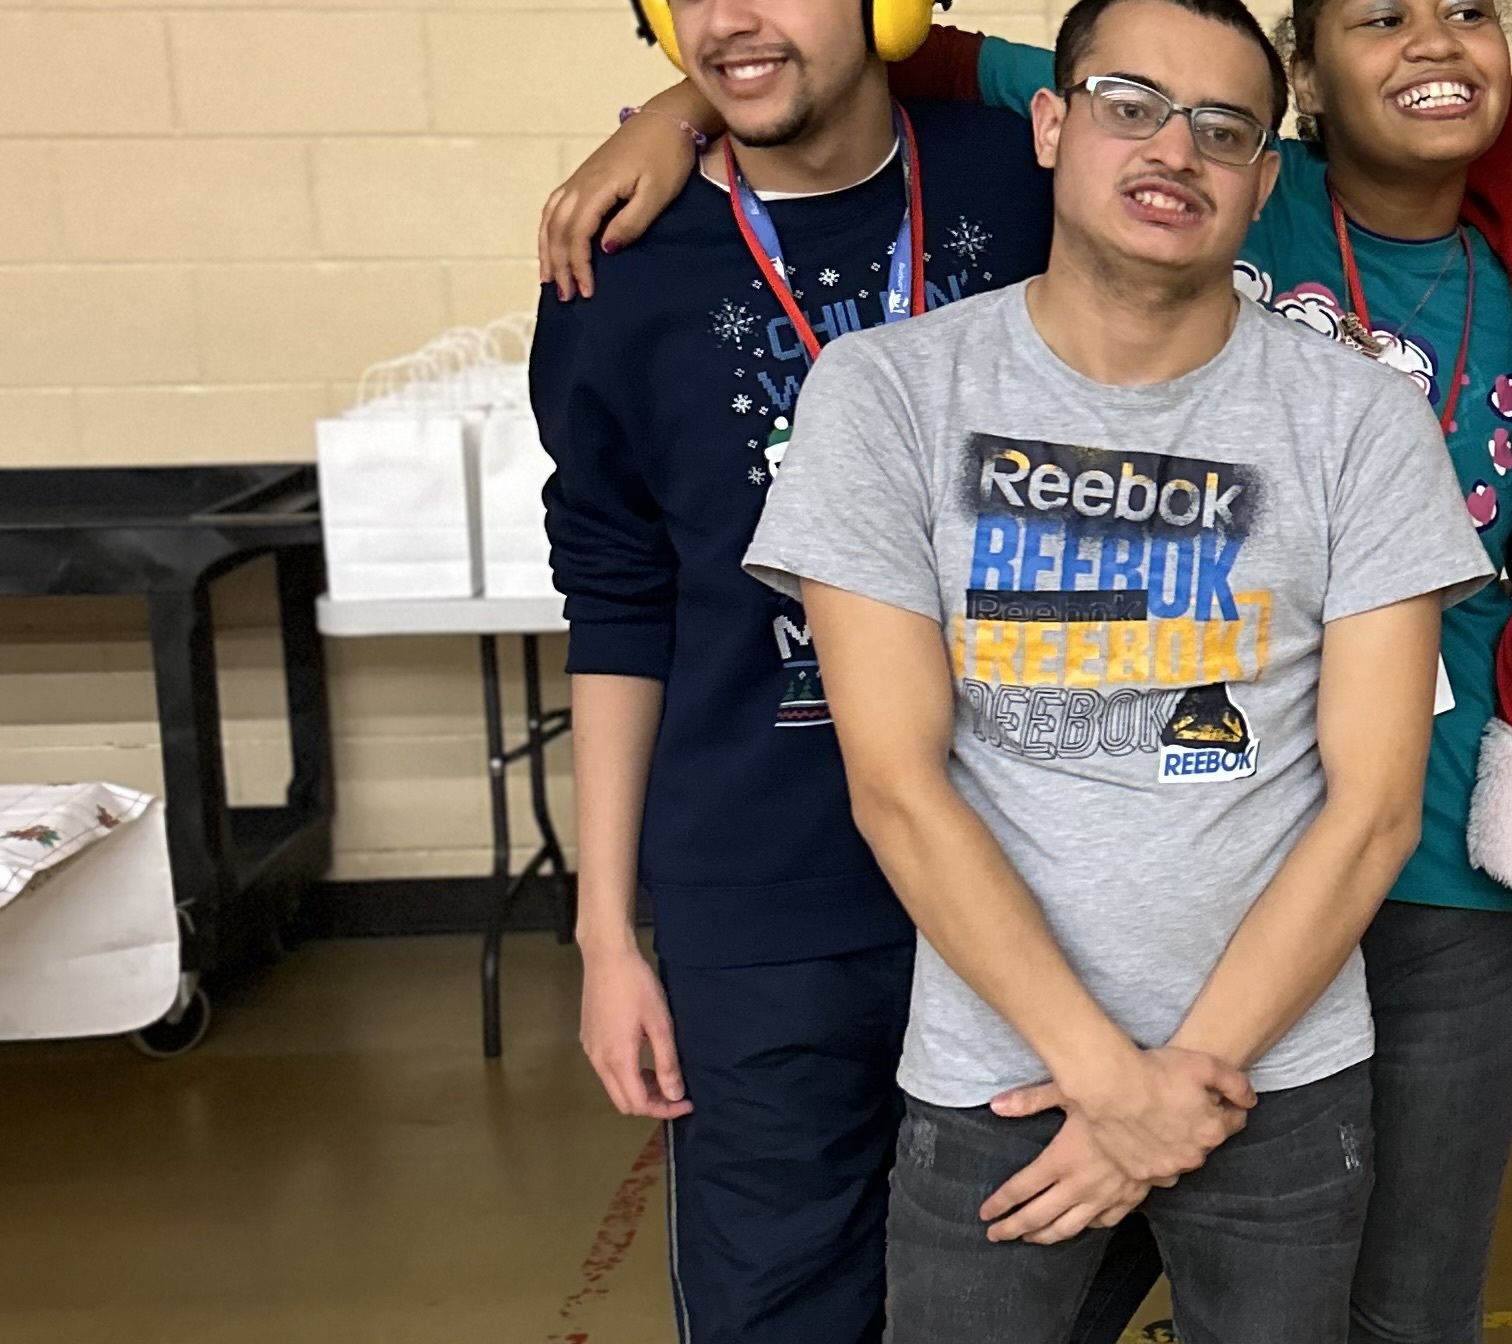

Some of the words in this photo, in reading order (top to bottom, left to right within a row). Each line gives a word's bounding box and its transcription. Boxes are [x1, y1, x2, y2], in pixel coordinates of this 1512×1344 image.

[979, 448, 1245, 529] Reebok
[973, 618, 1245, 686] REEBOK
[1164, 748, 1255, 777] REEBOK
